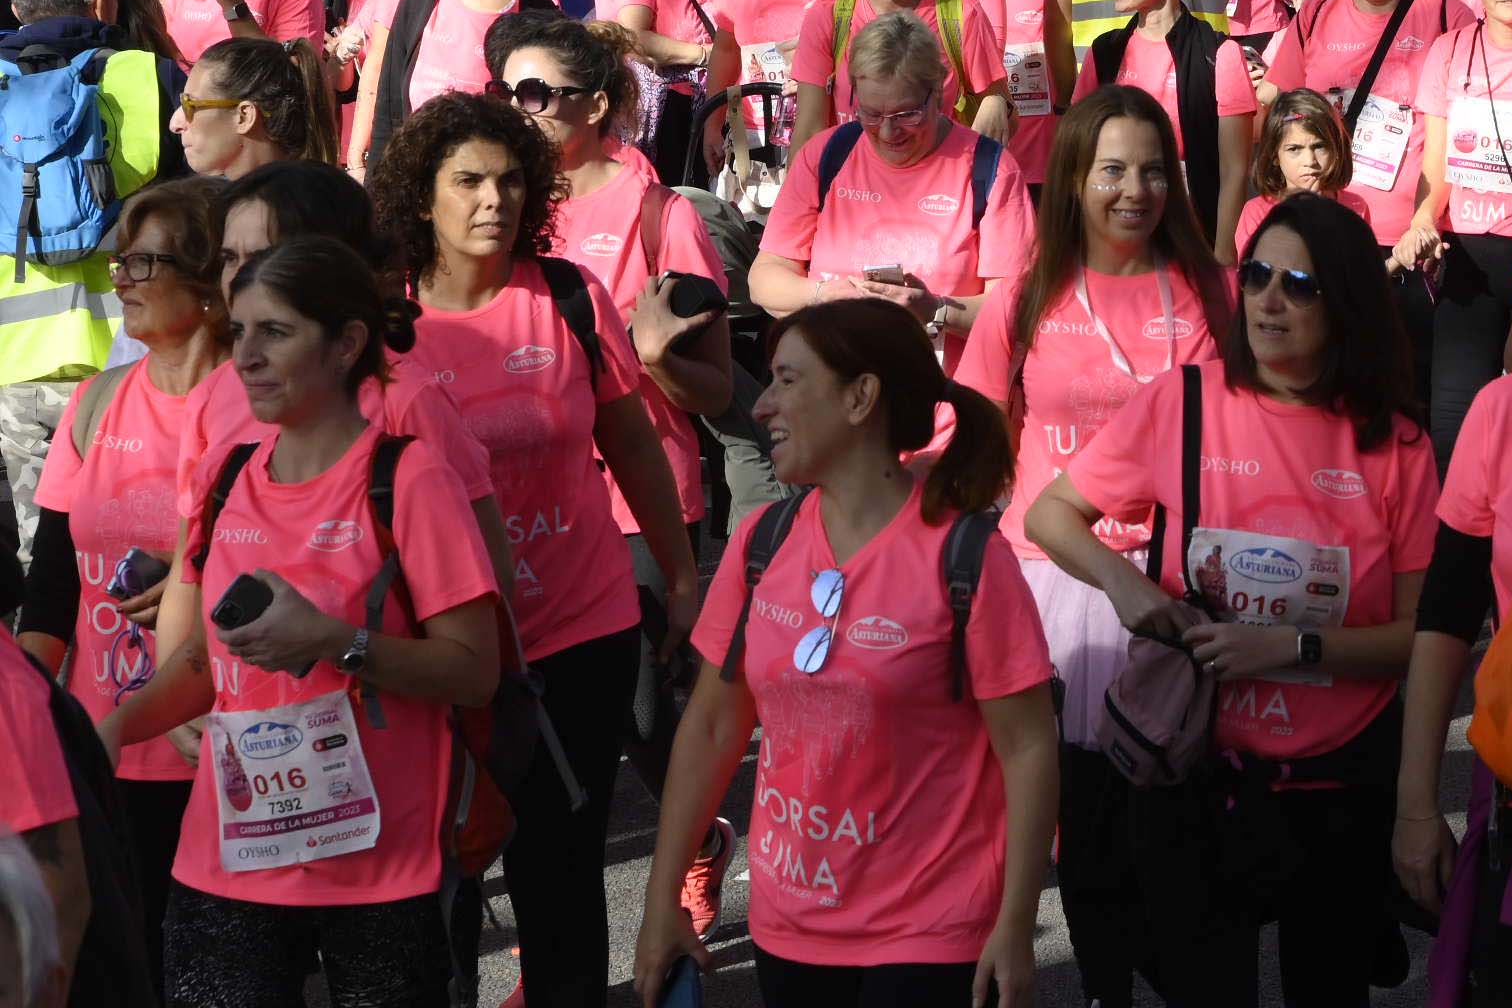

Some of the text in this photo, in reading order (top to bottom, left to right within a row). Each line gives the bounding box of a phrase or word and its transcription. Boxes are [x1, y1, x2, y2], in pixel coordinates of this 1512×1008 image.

[768, 70, 785, 82] 01
[1355, 128, 1373, 142] 16
[836, 187, 882, 203] OYSHO
[509, 353, 554, 370] ASTURIANA
[1044, 425, 1076, 455] TU
[506, 506, 572, 544] SAL
[1234, 555, 1297, 579] ASTURIANA
[1231, 591, 1288, 617] 016
[1222, 682, 1290, 722] MA
[308, 714, 340, 729] SUMA
[243, 733, 298, 753] ASTURIANA
[253, 767, 307, 795] 016
[269, 797, 303, 814] 7392
[240, 824, 272, 835] CARRERA
[274, 821, 286, 831] DE
[289, 820, 300, 830] LA
[302, 813, 335, 828] MUJER
[238, 826, 371, 860] OYSHO Santander
